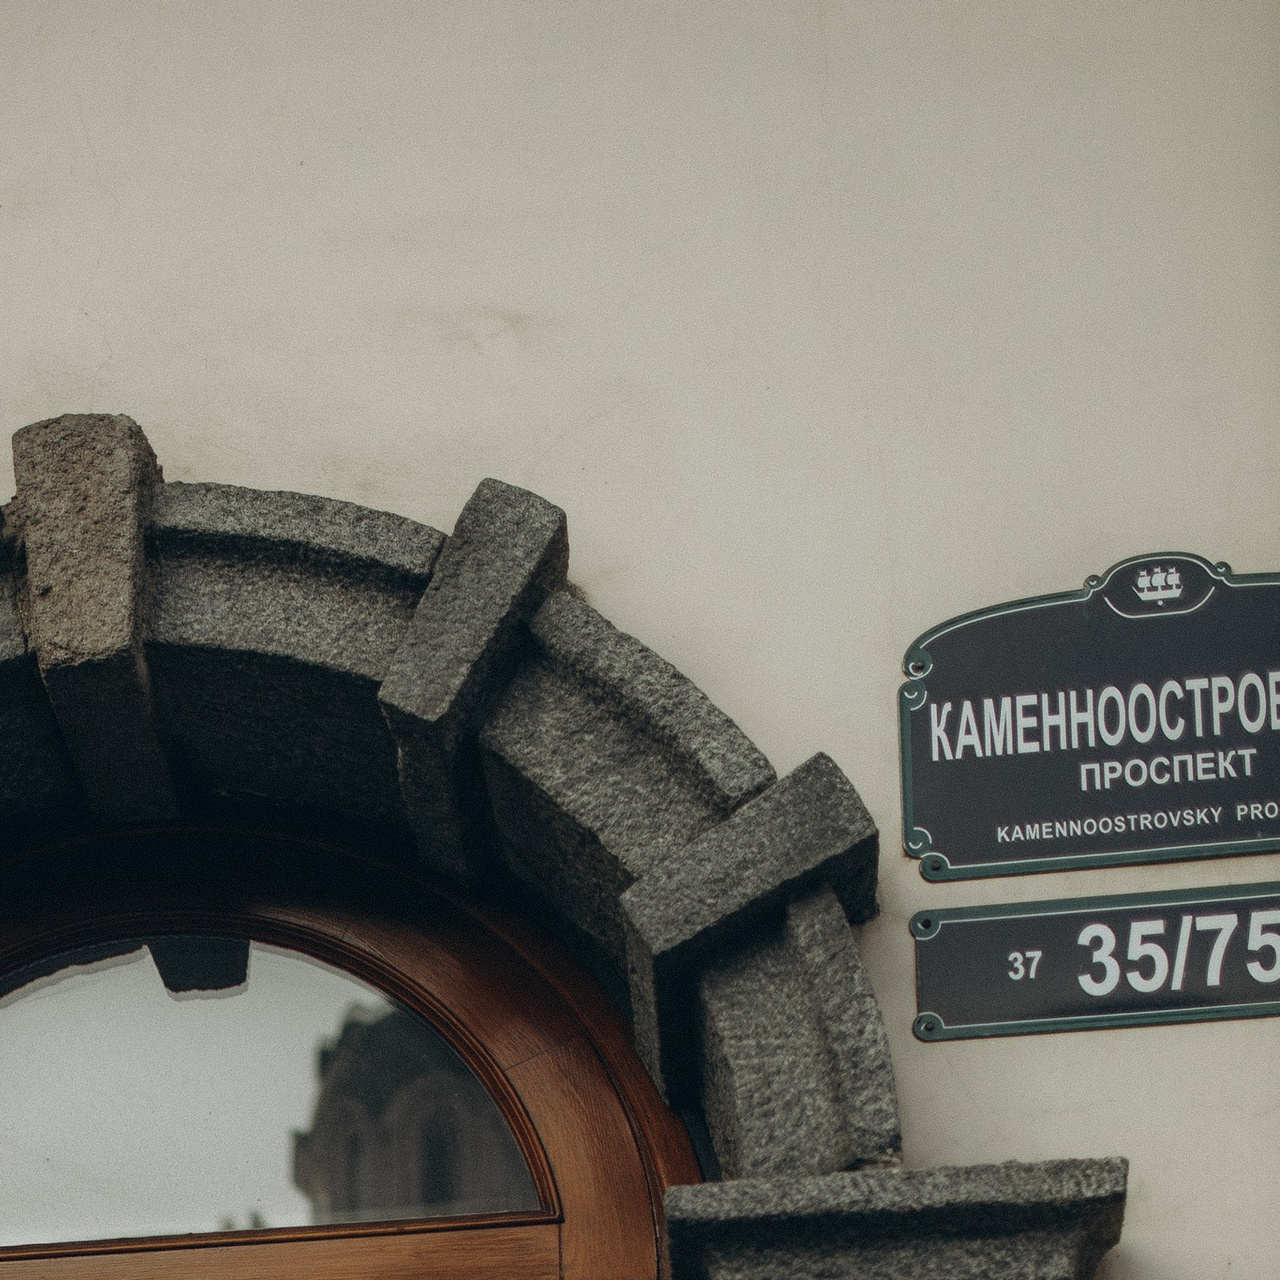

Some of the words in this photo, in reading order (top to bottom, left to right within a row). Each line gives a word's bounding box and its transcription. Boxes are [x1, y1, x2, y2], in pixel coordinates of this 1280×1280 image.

[1080, 748, 1258, 791] ПРОСПЕКТ
[996, 806, 1223, 843] KAMENNOOSTROVSKY
[1007, 950, 1043, 981] 37
[1076, 909, 1280, 997] 35/75
